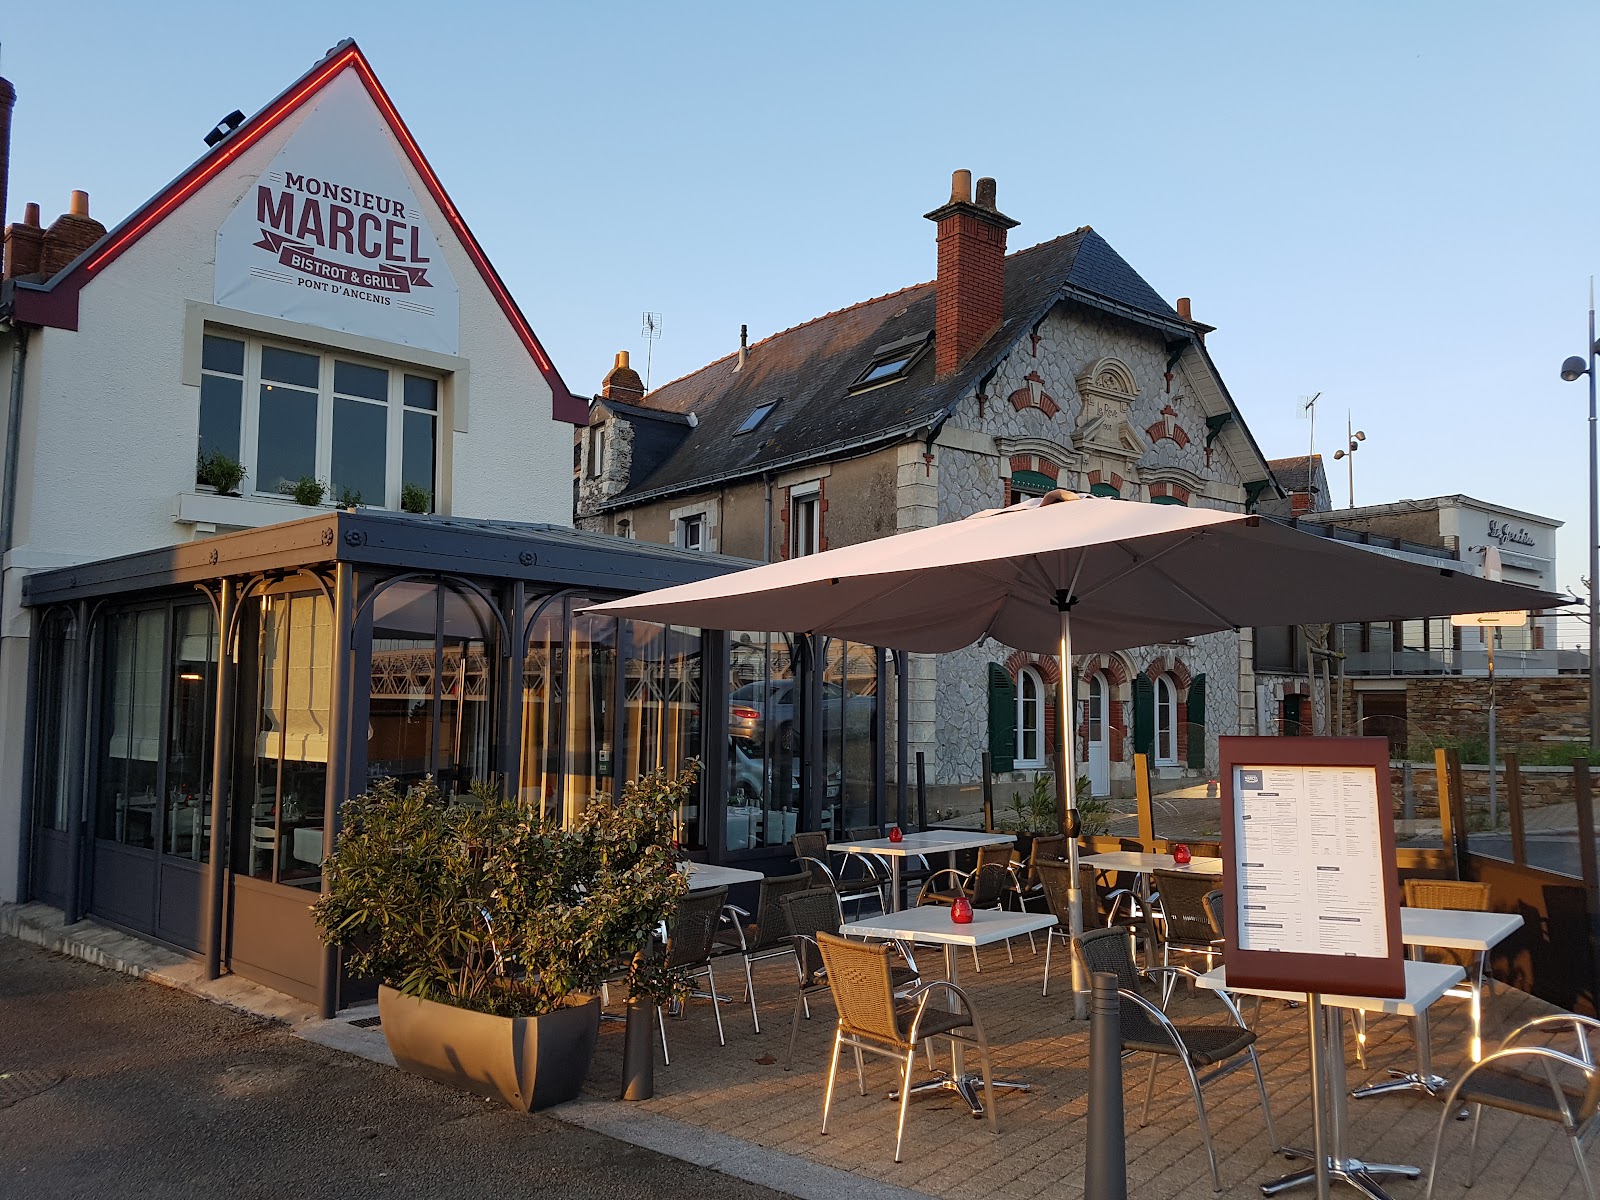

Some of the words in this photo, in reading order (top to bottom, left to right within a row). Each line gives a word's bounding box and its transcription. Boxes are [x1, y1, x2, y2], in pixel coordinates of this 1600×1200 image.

[285, 171, 406, 219] MONSIEUR
[257, 185, 430, 264] MARCEL
[291, 253, 348, 281] BISTROT
[350, 271, 360, 284] &
[363, 273, 401, 290] GRILL
[297, 277, 329, 293] PONT
[331, 284, 391, 306] D'ANCENIS
